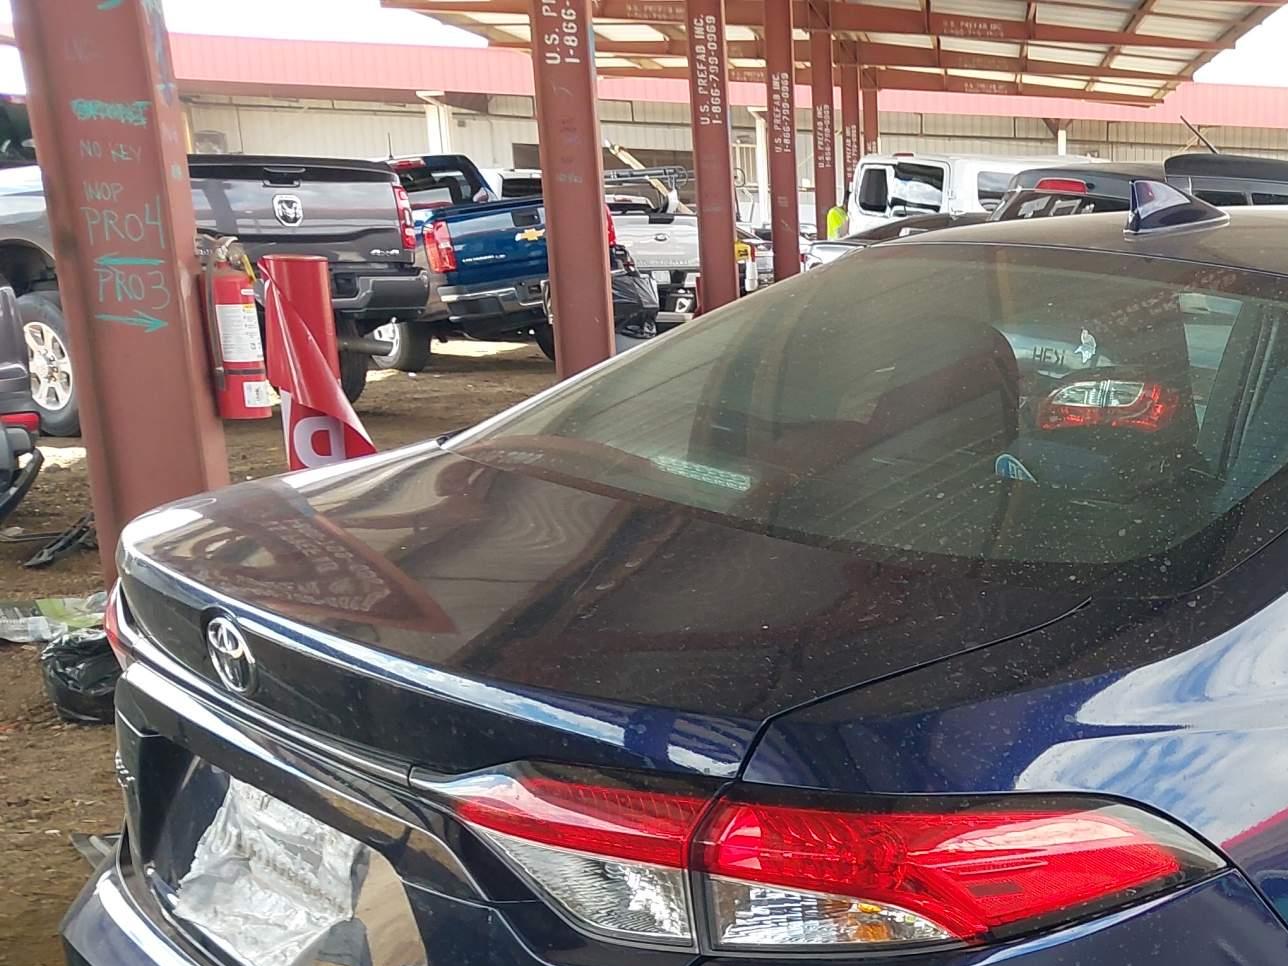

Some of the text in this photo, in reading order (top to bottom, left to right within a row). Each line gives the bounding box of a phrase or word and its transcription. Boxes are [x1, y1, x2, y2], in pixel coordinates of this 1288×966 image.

[695, 45, 709, 95] PREFAB
[705, 15, 722, 124] 1-866-799-0969
[772, 94, 781, 131] PREFAB
